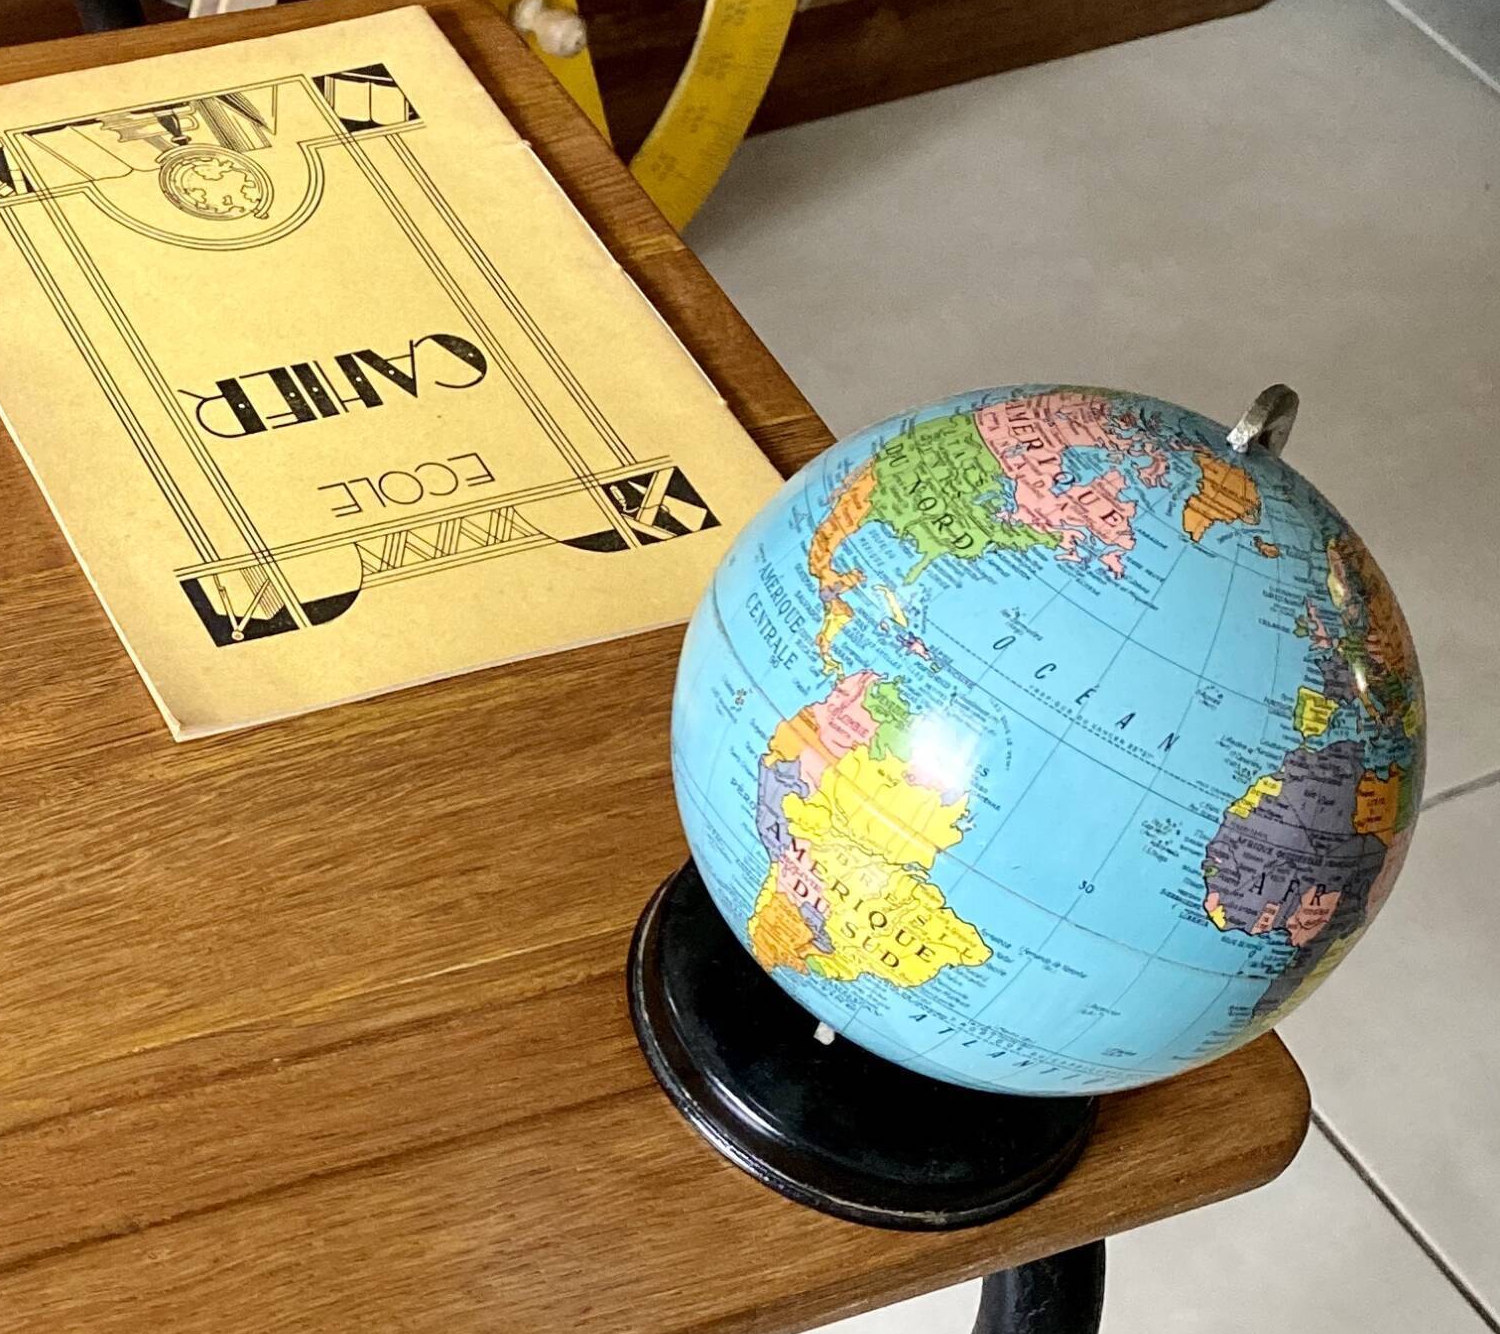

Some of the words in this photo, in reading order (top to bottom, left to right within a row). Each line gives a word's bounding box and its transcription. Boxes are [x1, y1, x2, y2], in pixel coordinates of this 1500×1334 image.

[178, 333, 488, 439] CAHIER
[318, 452, 496, 518] ECOLE
[746, 592, 798, 671] CENTRALE
[793, 878, 831, 915] DU
[839, 921, 900, 969] SUD
